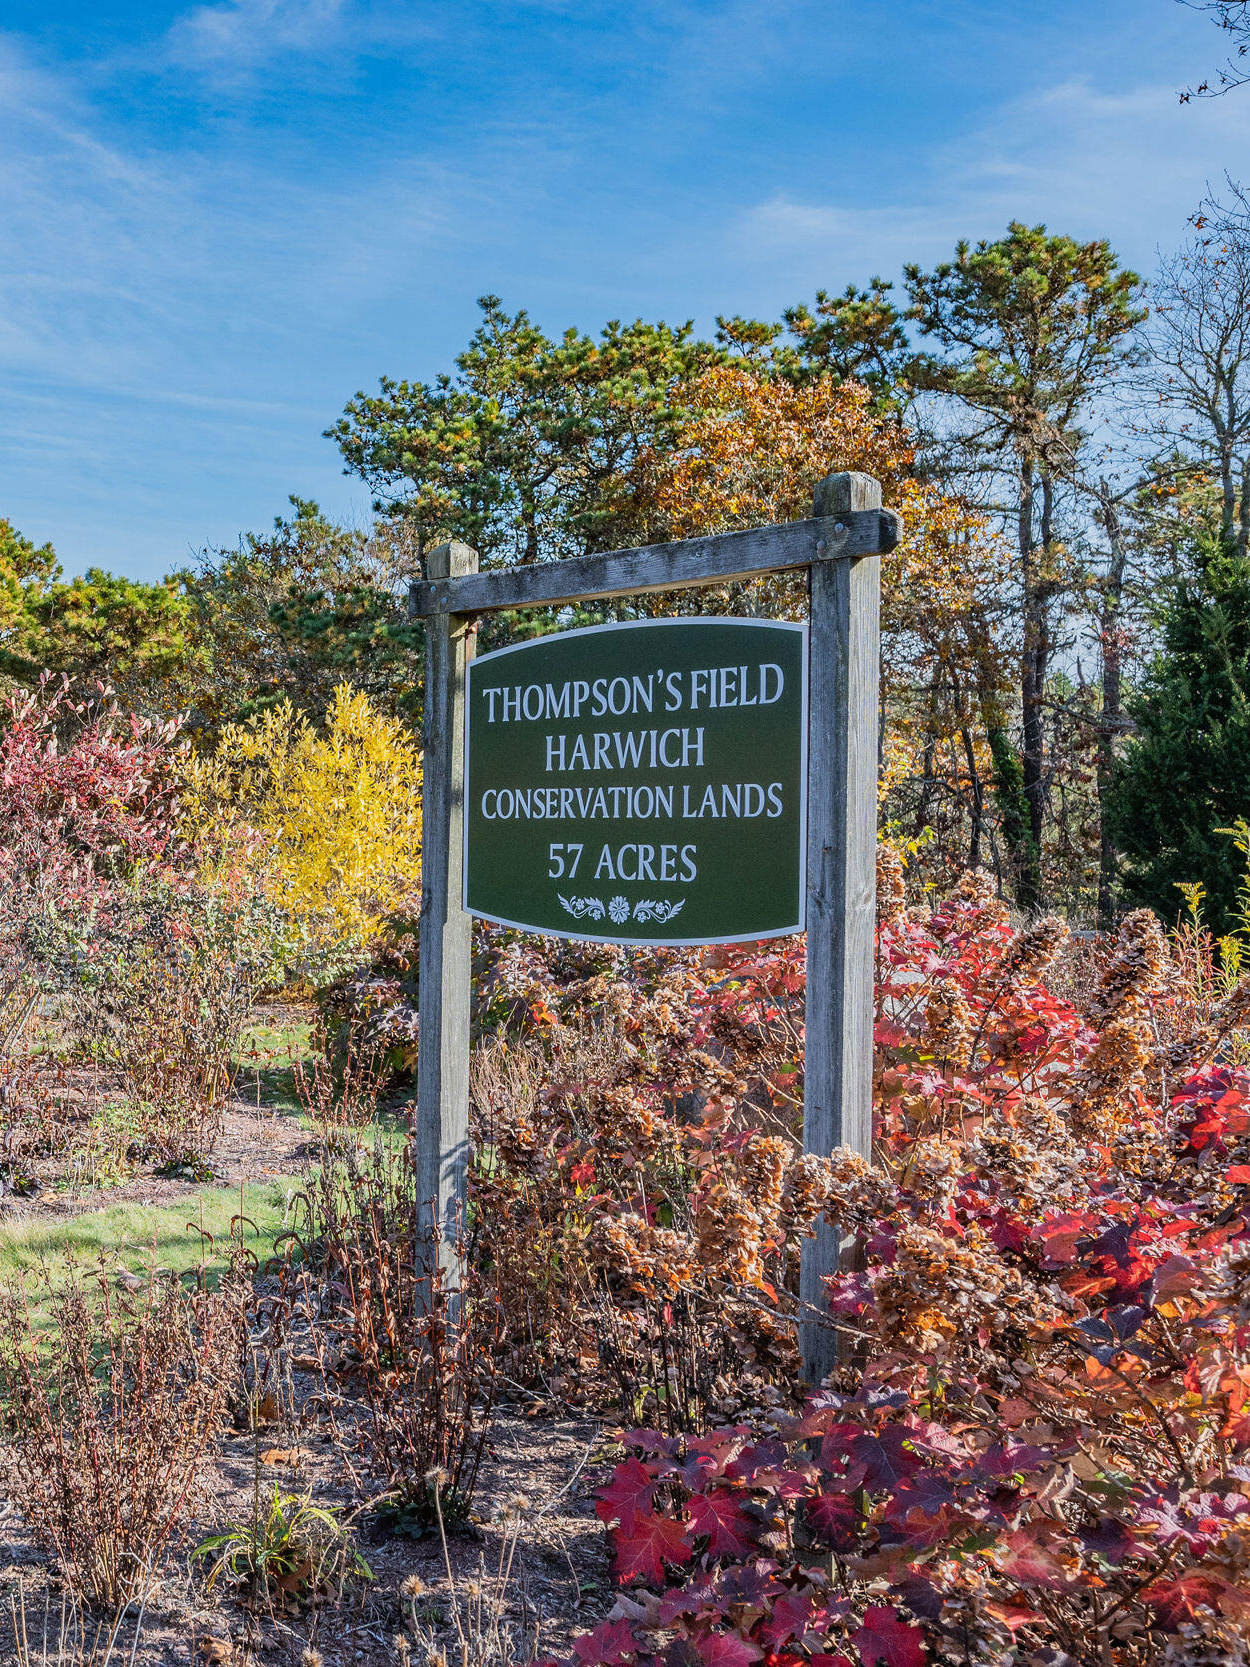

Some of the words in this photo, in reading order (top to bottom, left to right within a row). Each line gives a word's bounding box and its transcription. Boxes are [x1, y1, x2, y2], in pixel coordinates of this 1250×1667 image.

[482, 669, 682, 723] THOMPSON'S
[690, 663, 785, 710] FIELD
[545, 727, 705, 772] HARWICH
[481, 785, 674, 820] CONSERVATION
[682, 782, 783, 818] LANDS
[548, 843, 584, 879] 57
[593, 843, 697, 882] ACRES
